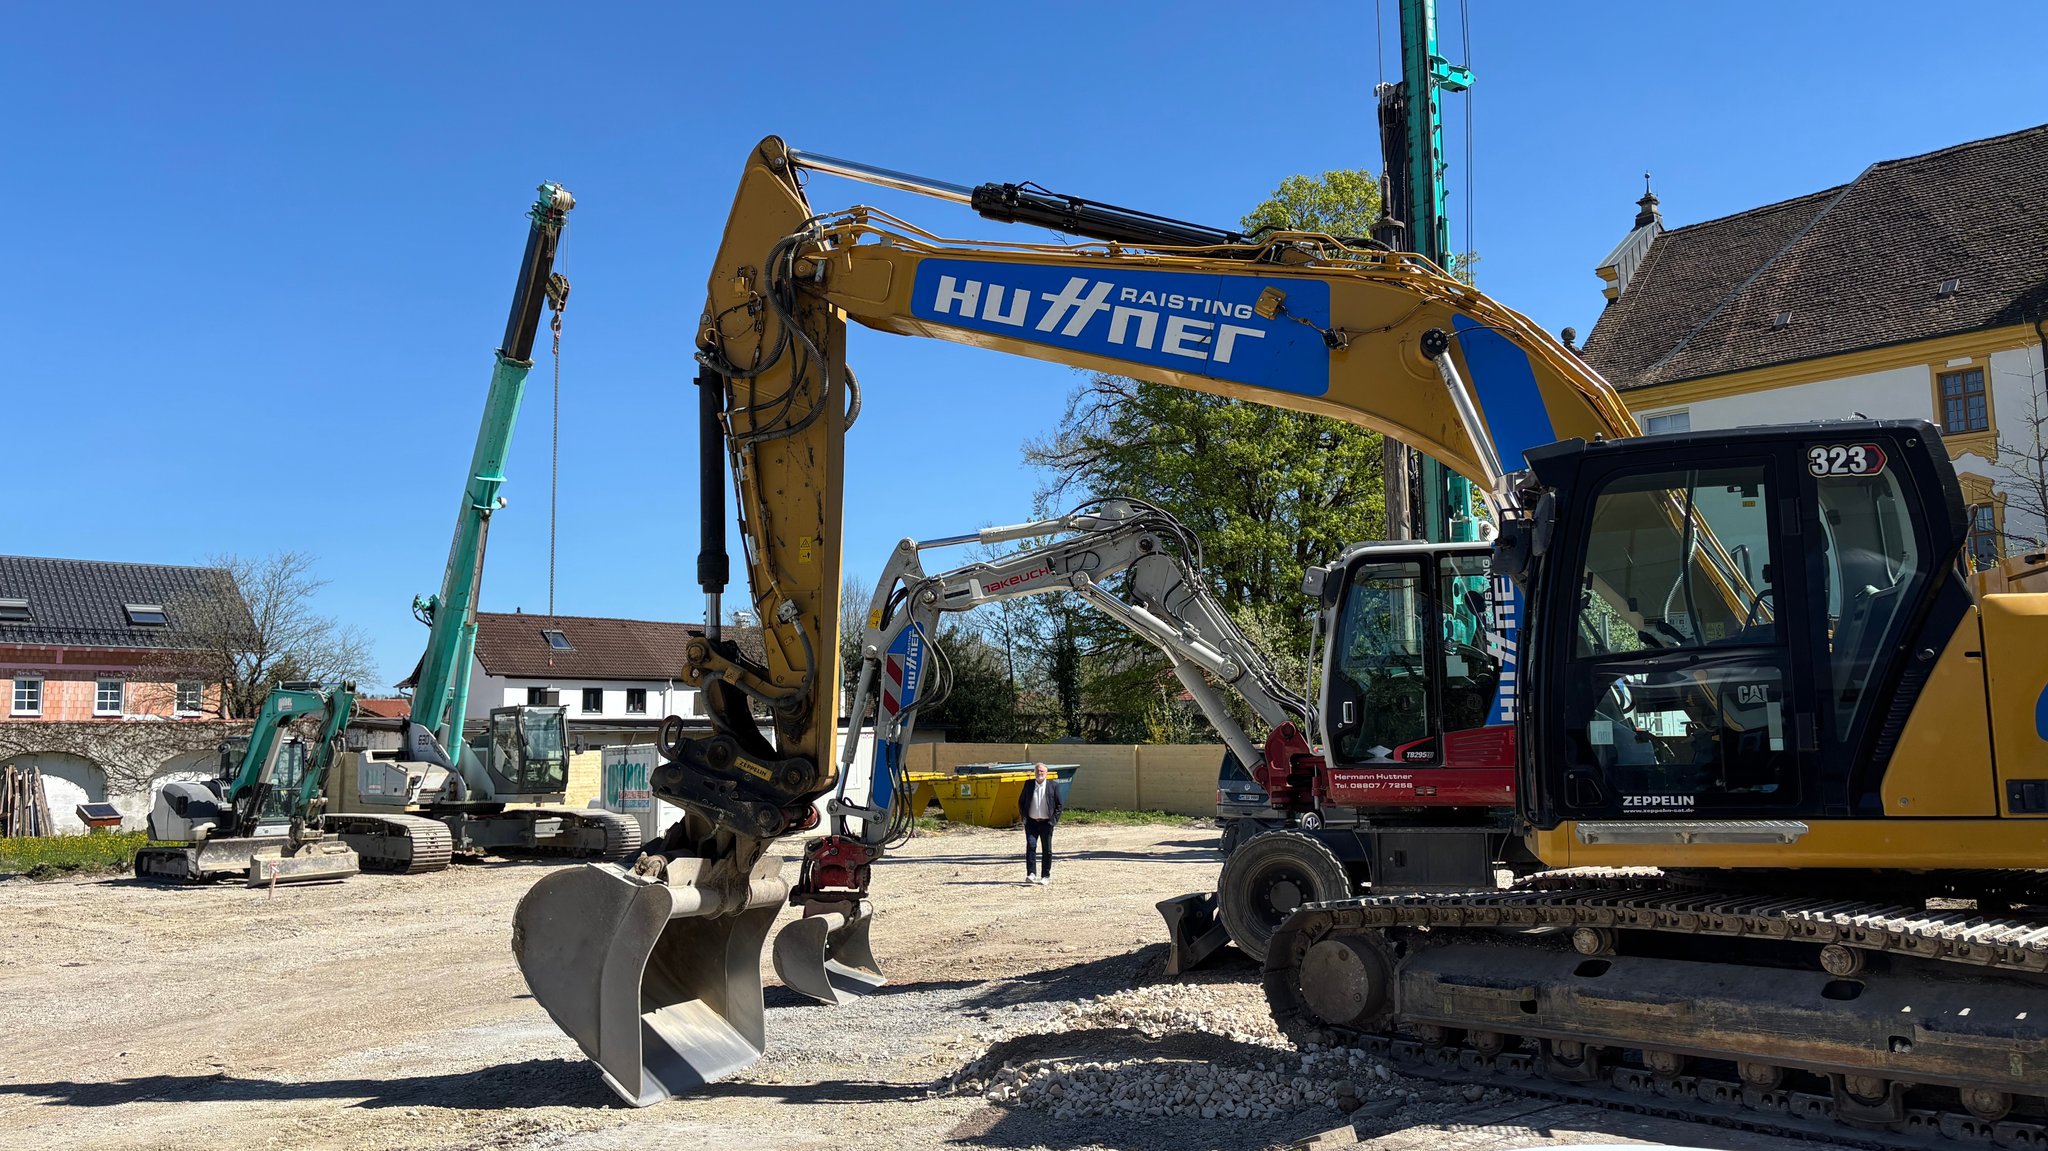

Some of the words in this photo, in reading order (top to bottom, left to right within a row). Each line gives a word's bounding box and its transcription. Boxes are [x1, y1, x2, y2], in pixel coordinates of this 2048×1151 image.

[1120, 286, 1253, 320] RAISTING
[1810, 446, 1868, 475] 323
[1737, 684, 1769, 704] CAT
[738, 761, 767, 777] ZEPPELIN
[1622, 795, 1695, 806] ZEPPELIN
